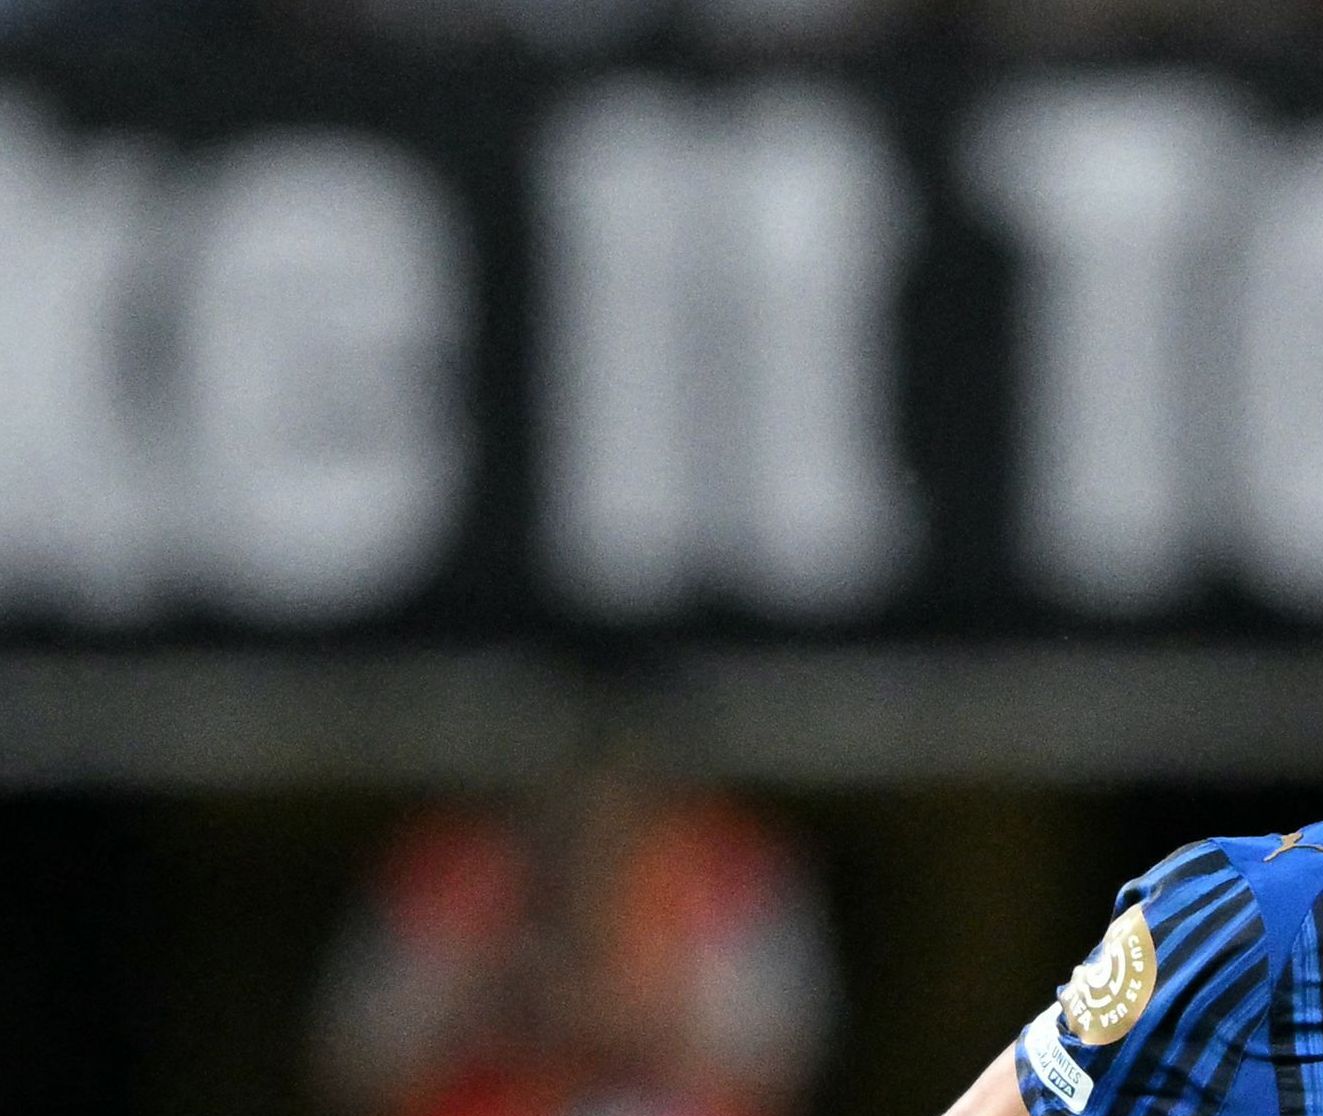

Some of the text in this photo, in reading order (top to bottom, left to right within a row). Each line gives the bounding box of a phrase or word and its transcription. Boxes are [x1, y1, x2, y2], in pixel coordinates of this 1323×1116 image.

[1100, 935, 1144, 1028] CUP 25 USA
[1052, 1045, 1081, 1084] UNITES
